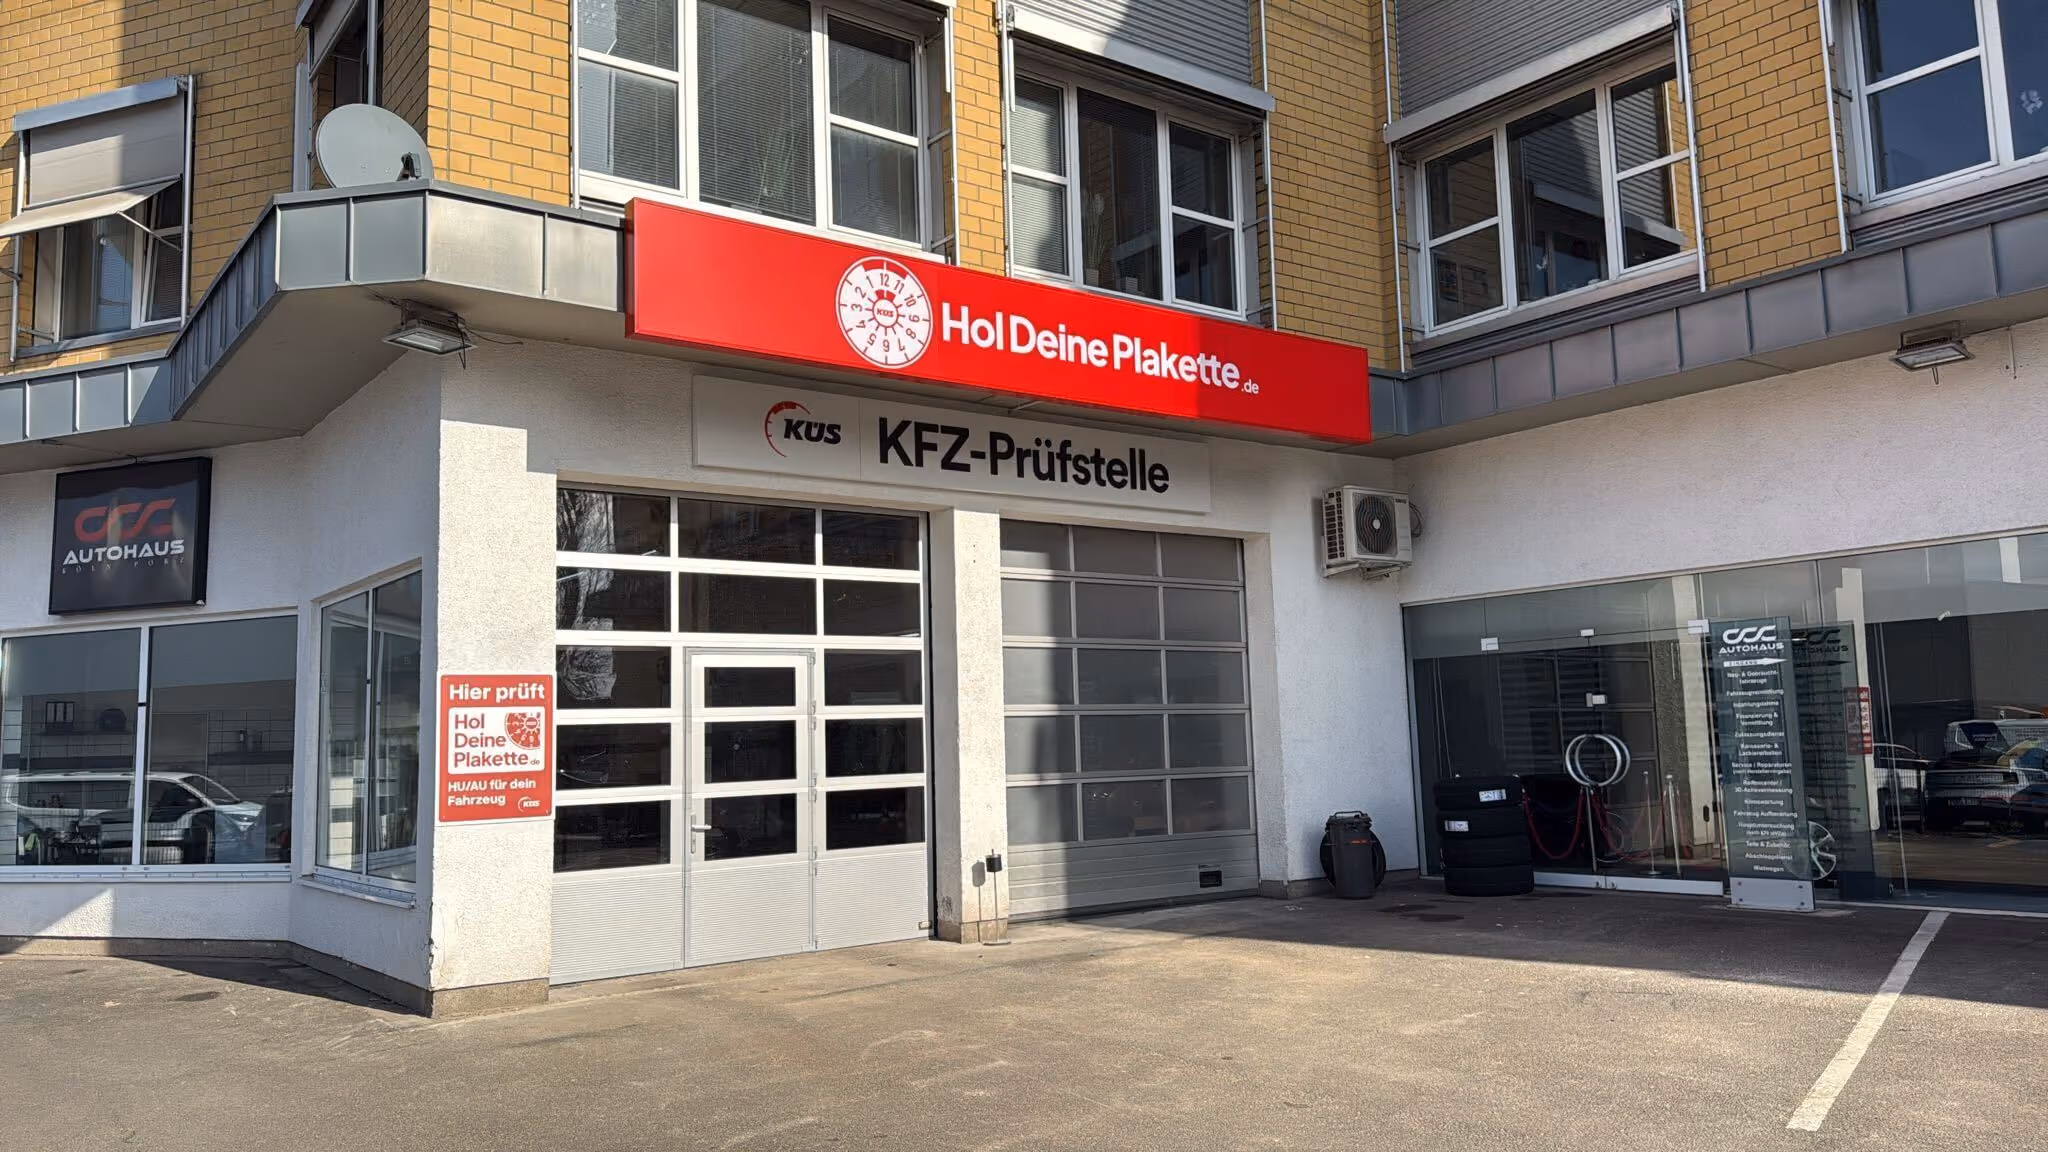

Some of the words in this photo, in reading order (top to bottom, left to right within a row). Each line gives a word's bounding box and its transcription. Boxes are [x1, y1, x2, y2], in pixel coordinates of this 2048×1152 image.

[880, 273, 890, 287] 12
[783, 417, 842, 445] KÜS
[878, 416, 1170, 494] KFZ-Prüfstelle
[63, 539, 185, 566] AUTOHAUS
[1718, 642, 1785, 654] AUTOHAUS
[449, 683, 491, 701] Hier
[495, 682, 545, 703] prüft
[454, 713, 485, 730] Hol
[454, 732, 507, 749] Deine
[447, 780, 487, 792] HU/AU
[490, 779, 507, 790] für
[510, 778, 536, 790] dein
[447, 794, 506, 807] Fahrzeug
